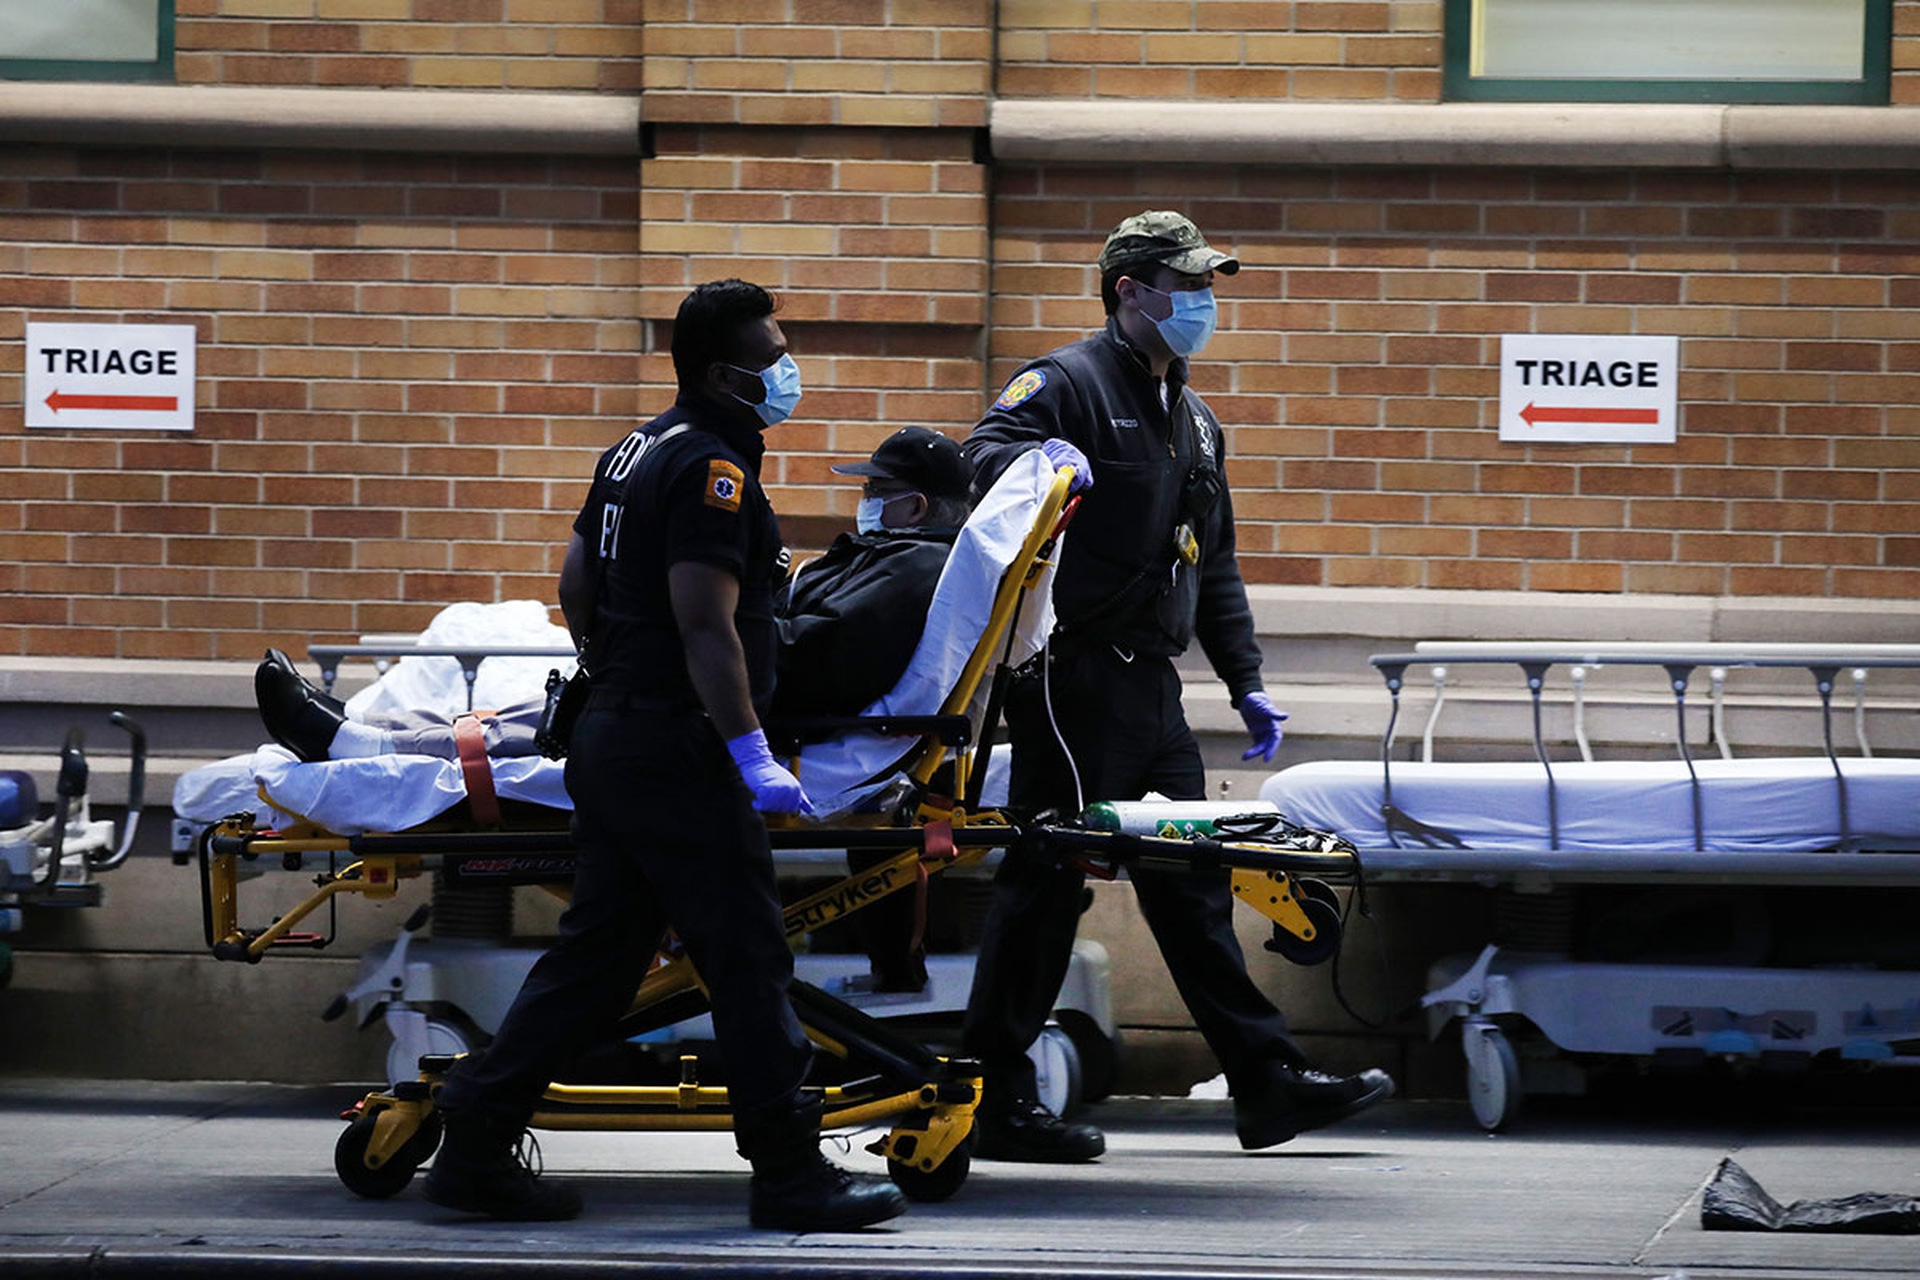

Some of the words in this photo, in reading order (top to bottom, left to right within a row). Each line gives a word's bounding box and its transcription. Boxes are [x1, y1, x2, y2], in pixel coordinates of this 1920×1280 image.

[41, 348, 178, 375] TRIAGE
[1515, 360, 1659, 388] TRIAGE
[784, 867, 897, 937] stryker
